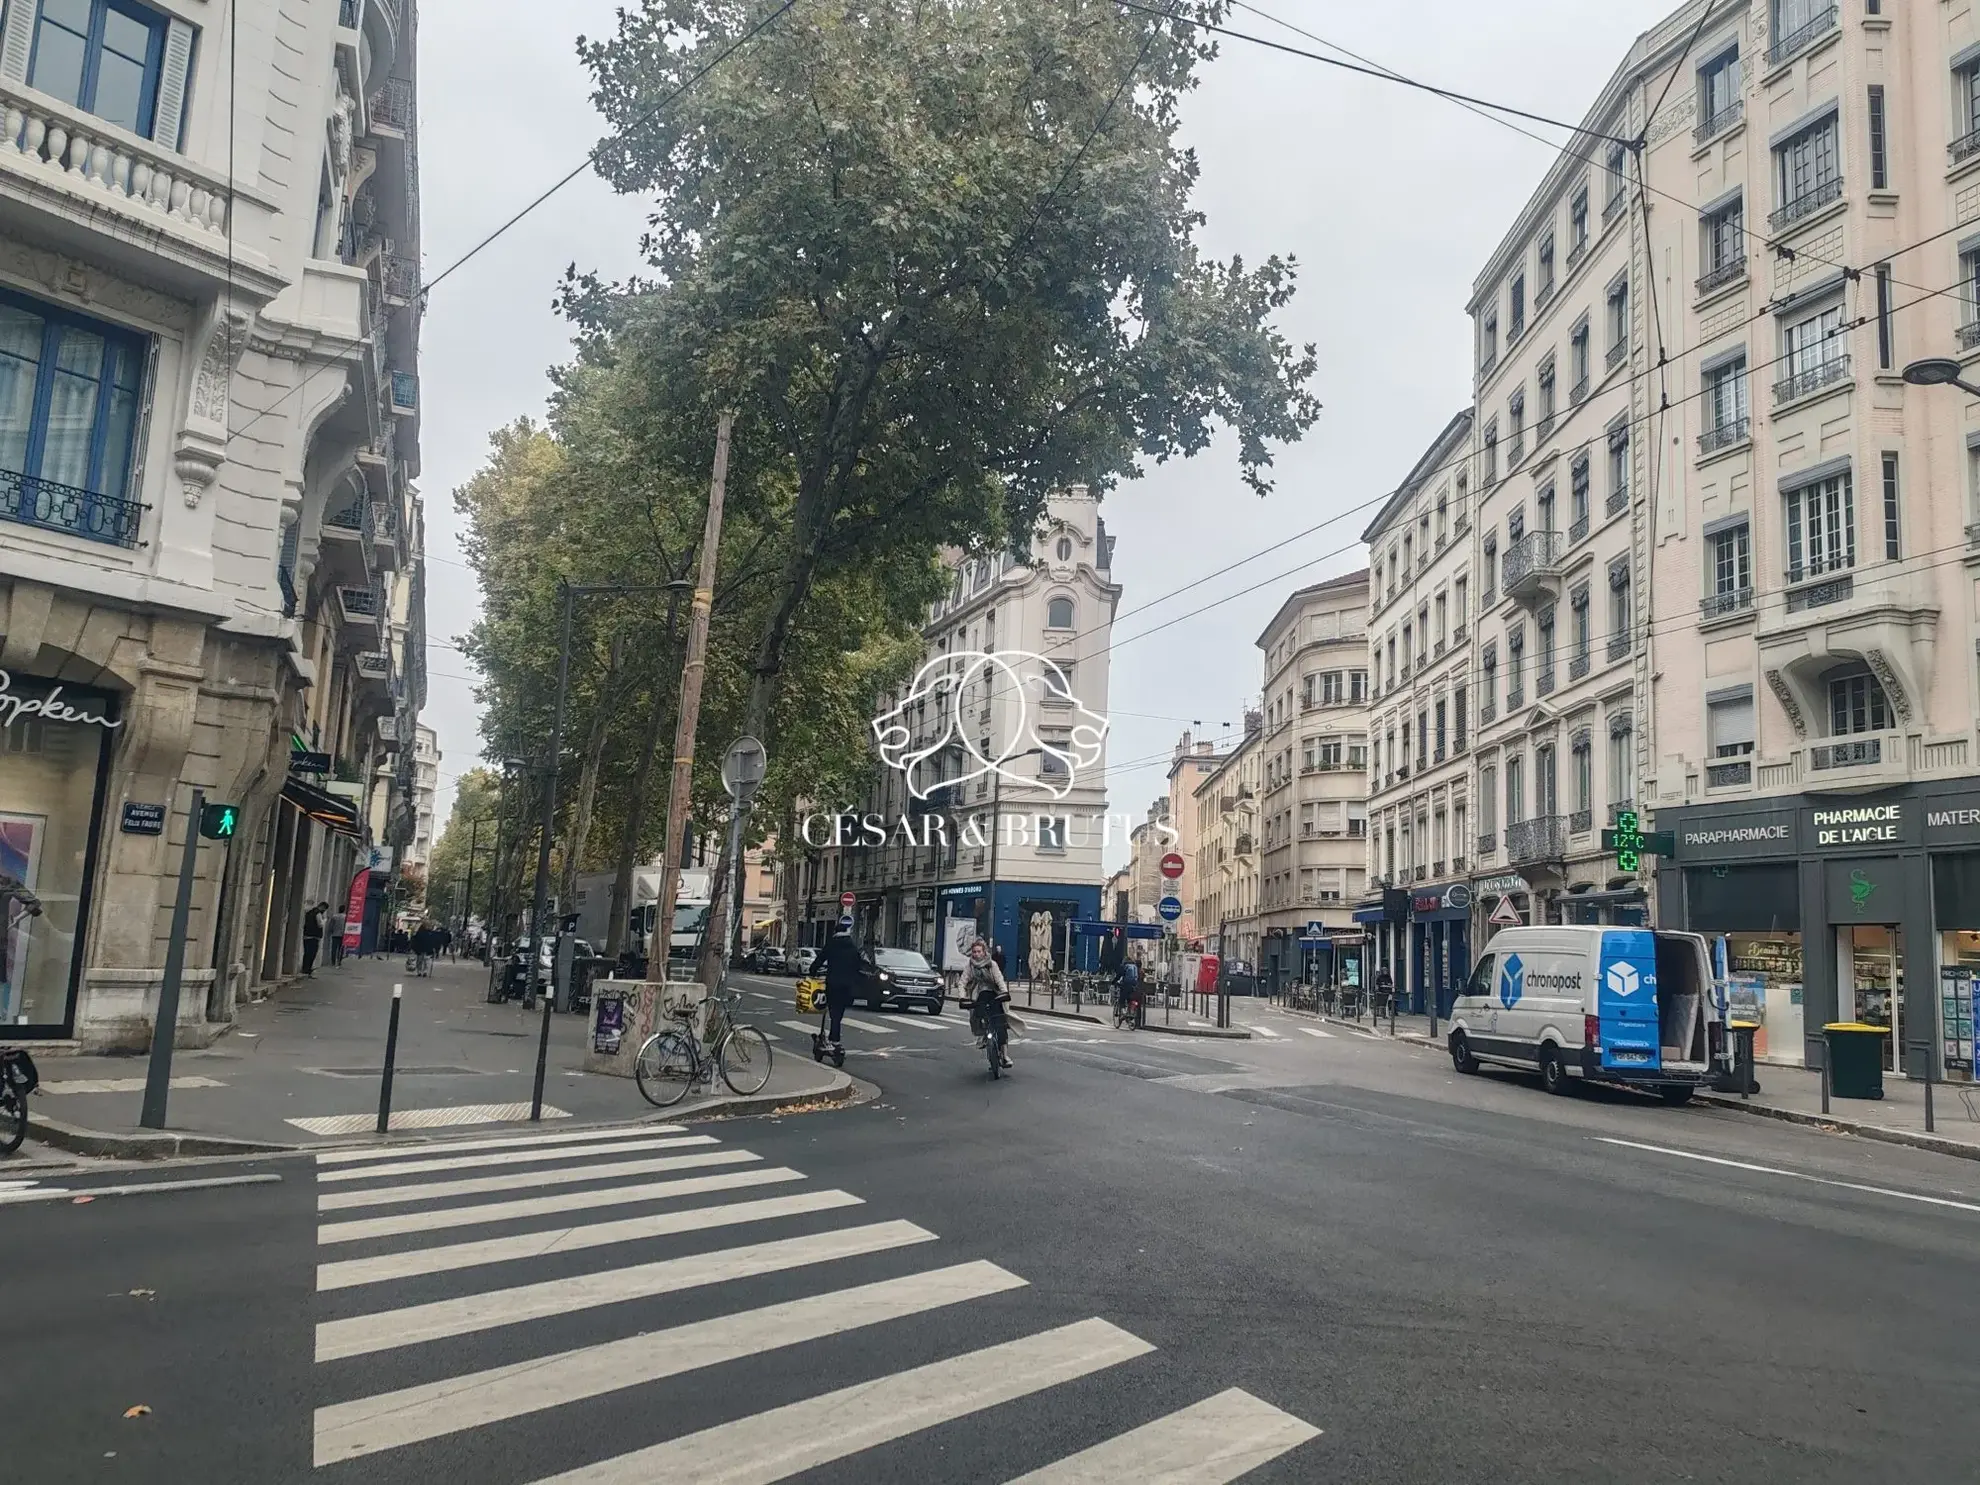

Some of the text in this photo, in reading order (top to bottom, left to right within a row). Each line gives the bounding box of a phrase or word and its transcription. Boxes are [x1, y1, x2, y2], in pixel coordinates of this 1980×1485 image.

[130, 810, 159, 818] AVENUE
[1813, 805, 1901, 826] PHARMACIE
[1927, 808, 1980, 827] MATER
[1612, 833, 1645, 849] 12°C
[1685, 825, 1790, 846] PARAPHARMACIE
[1818, 825, 1897, 845] DE L'AIGLE
[568, 922, 575, 931] P
[1526, 970, 1582, 993] chronopost
[813, 993, 827, 1004] JD
